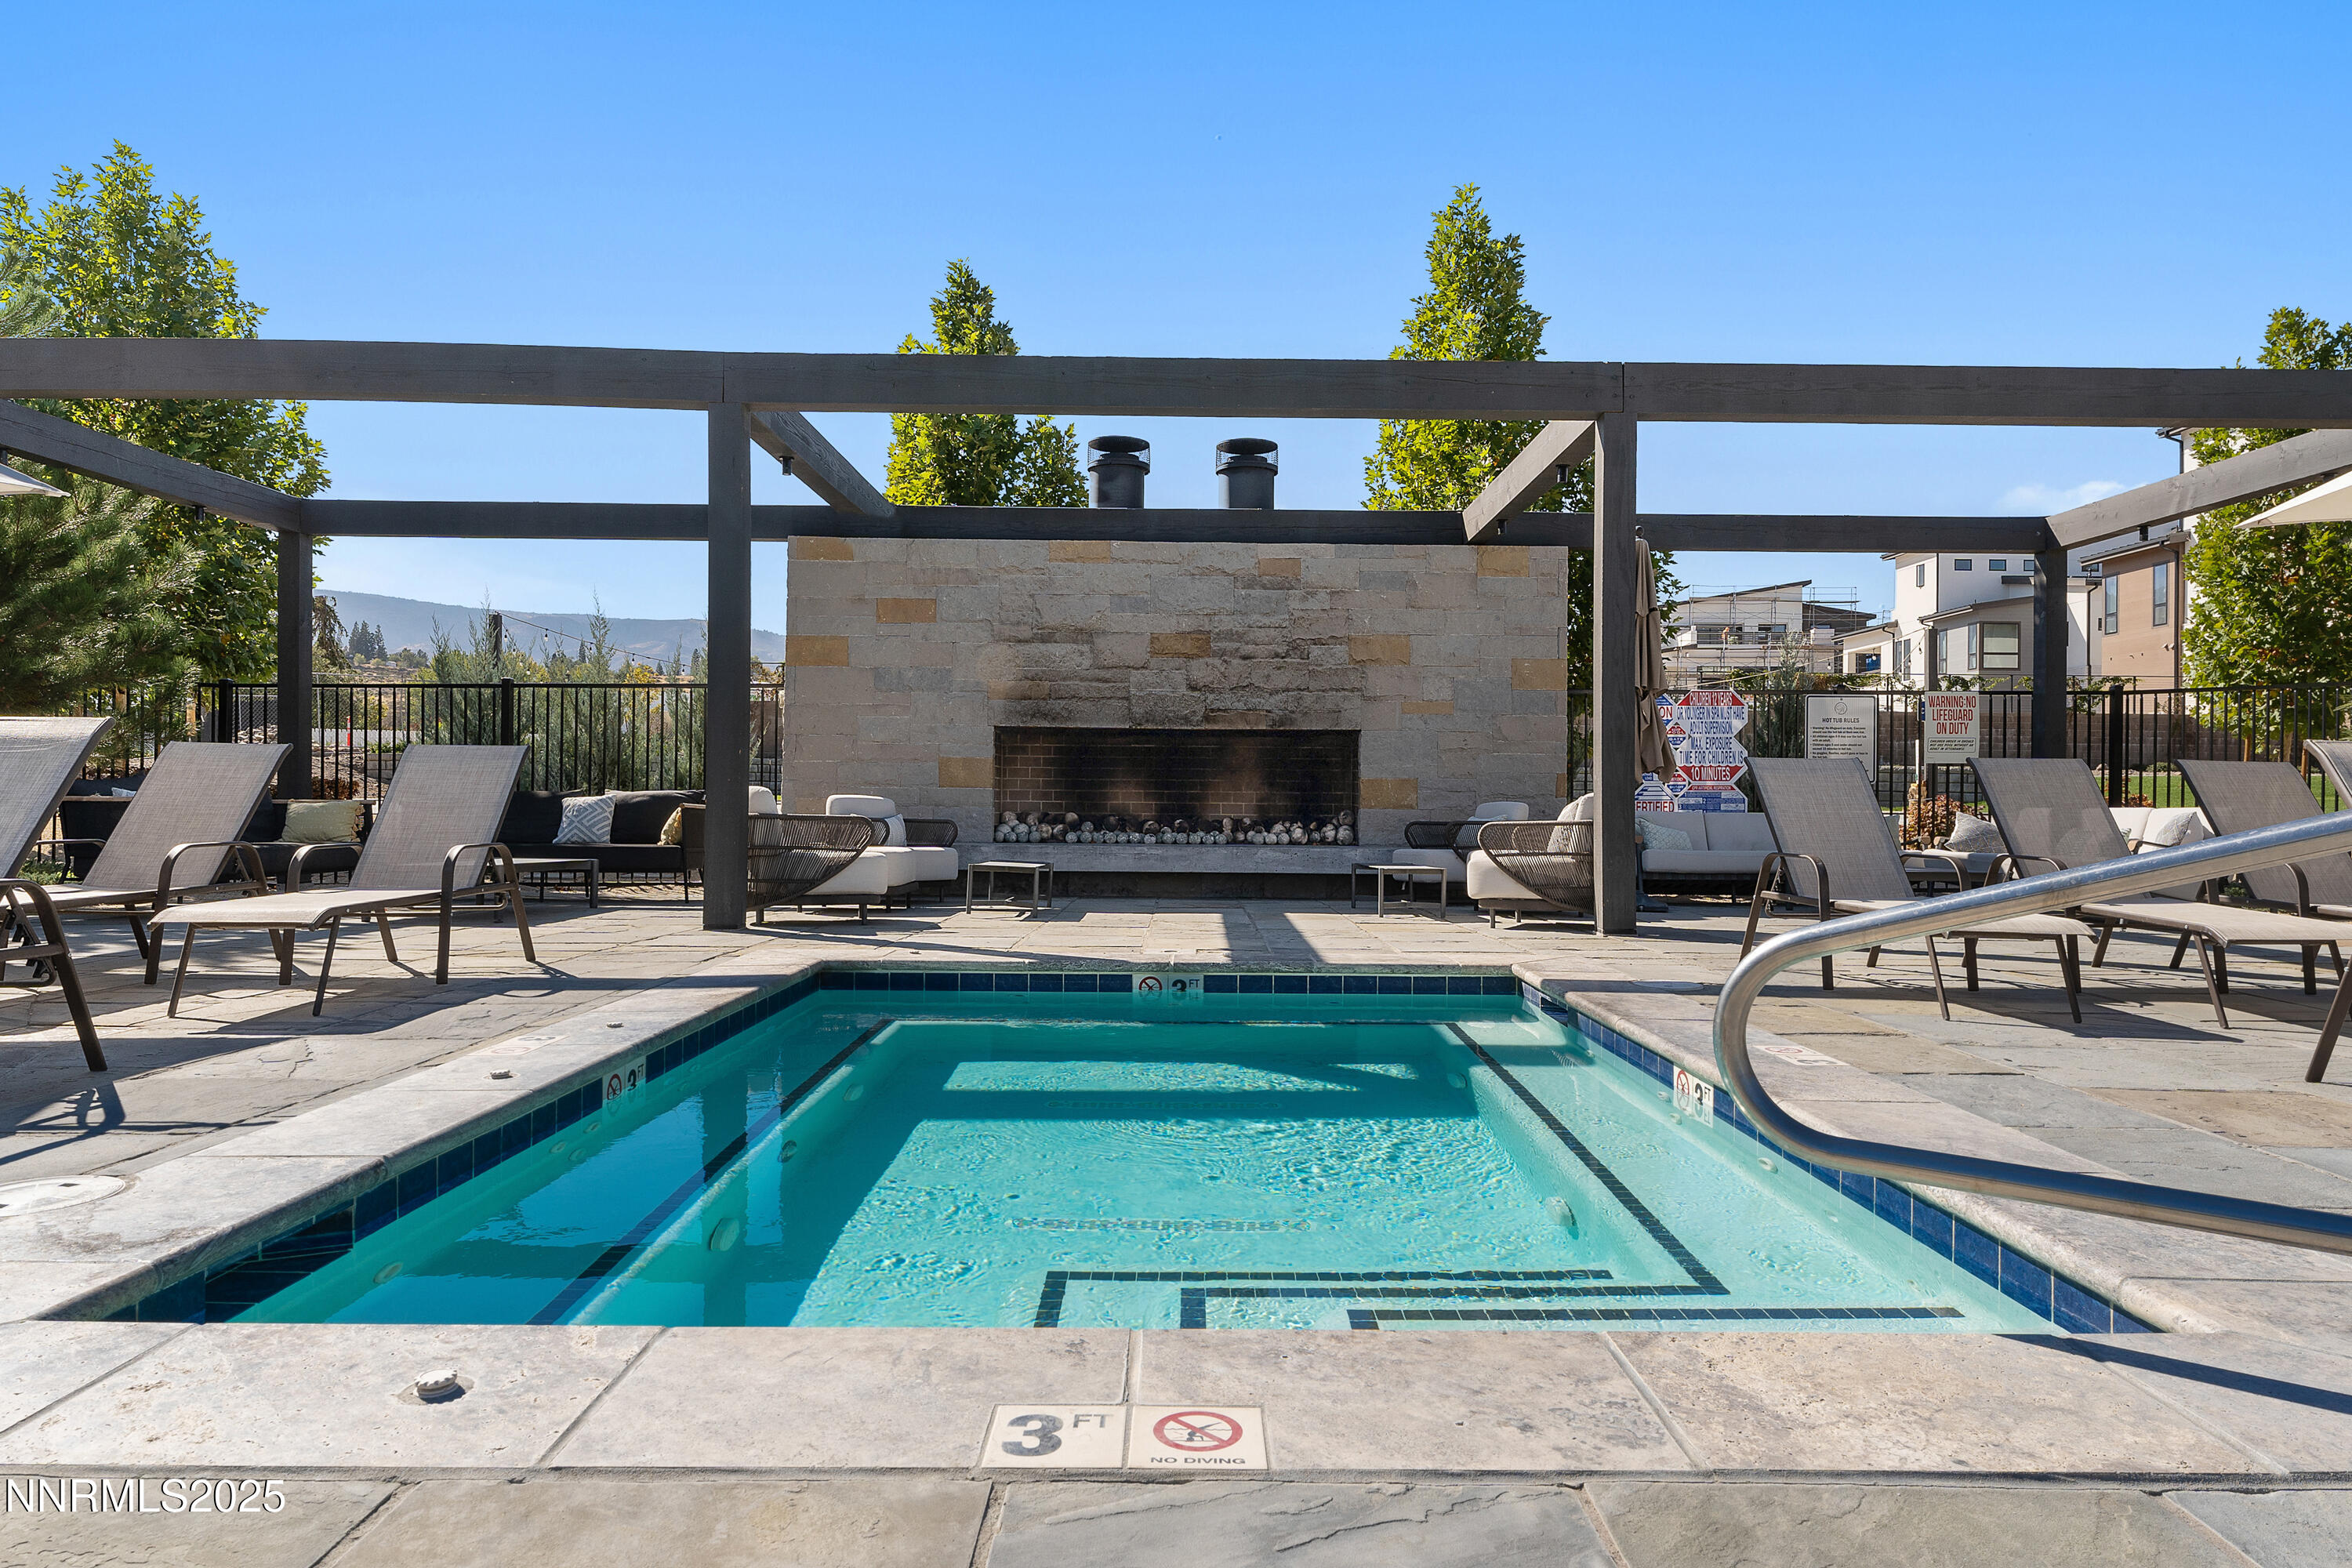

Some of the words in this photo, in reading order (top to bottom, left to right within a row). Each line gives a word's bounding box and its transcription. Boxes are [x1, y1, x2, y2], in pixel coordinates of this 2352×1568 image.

[1690, 691, 1711, 706] CHILDREN
[1712, 691, 1717, 706] 12
[1718, 691, 1733, 706] YEARS
[1677, 707, 1683, 720] OR
[1685, 707, 1705, 720] YOUNGER
[1706, 707, 1710, 720] IN
[1721, 707, 1732, 720] MUST
[1733, 707, 1744, 720] HAVE
[1933, 709, 1973, 720] LIFEGUARD
[1690, 721, 1704, 734] ADULT
[1936, 722, 1947, 734] ON
[1949, 722, 1969, 734] DUTY
[1691, 737, 1703, 750] MAX.
[1706, 737, 1732, 750] EXPOSURE
[1680, 751, 1692, 764] TIME
[1695, 751, 1706, 764] FOR
[1708, 751, 1736, 764] CHILDREN
[1738, 751, 1744, 764] IS
[1691, 767, 1700, 780] 10
[1701, 767, 1730, 780] MINUTES
[1636, 801, 1675, 812] ERTIFIED
[1189, 979, 1200, 988] FT
[637, 1064, 644, 1079] FT
[1704, 1087, 1711, 1101] FT
[1001, 1414, 1064, 1457] 3
[1073, 1414, 1114, 1428] FT
